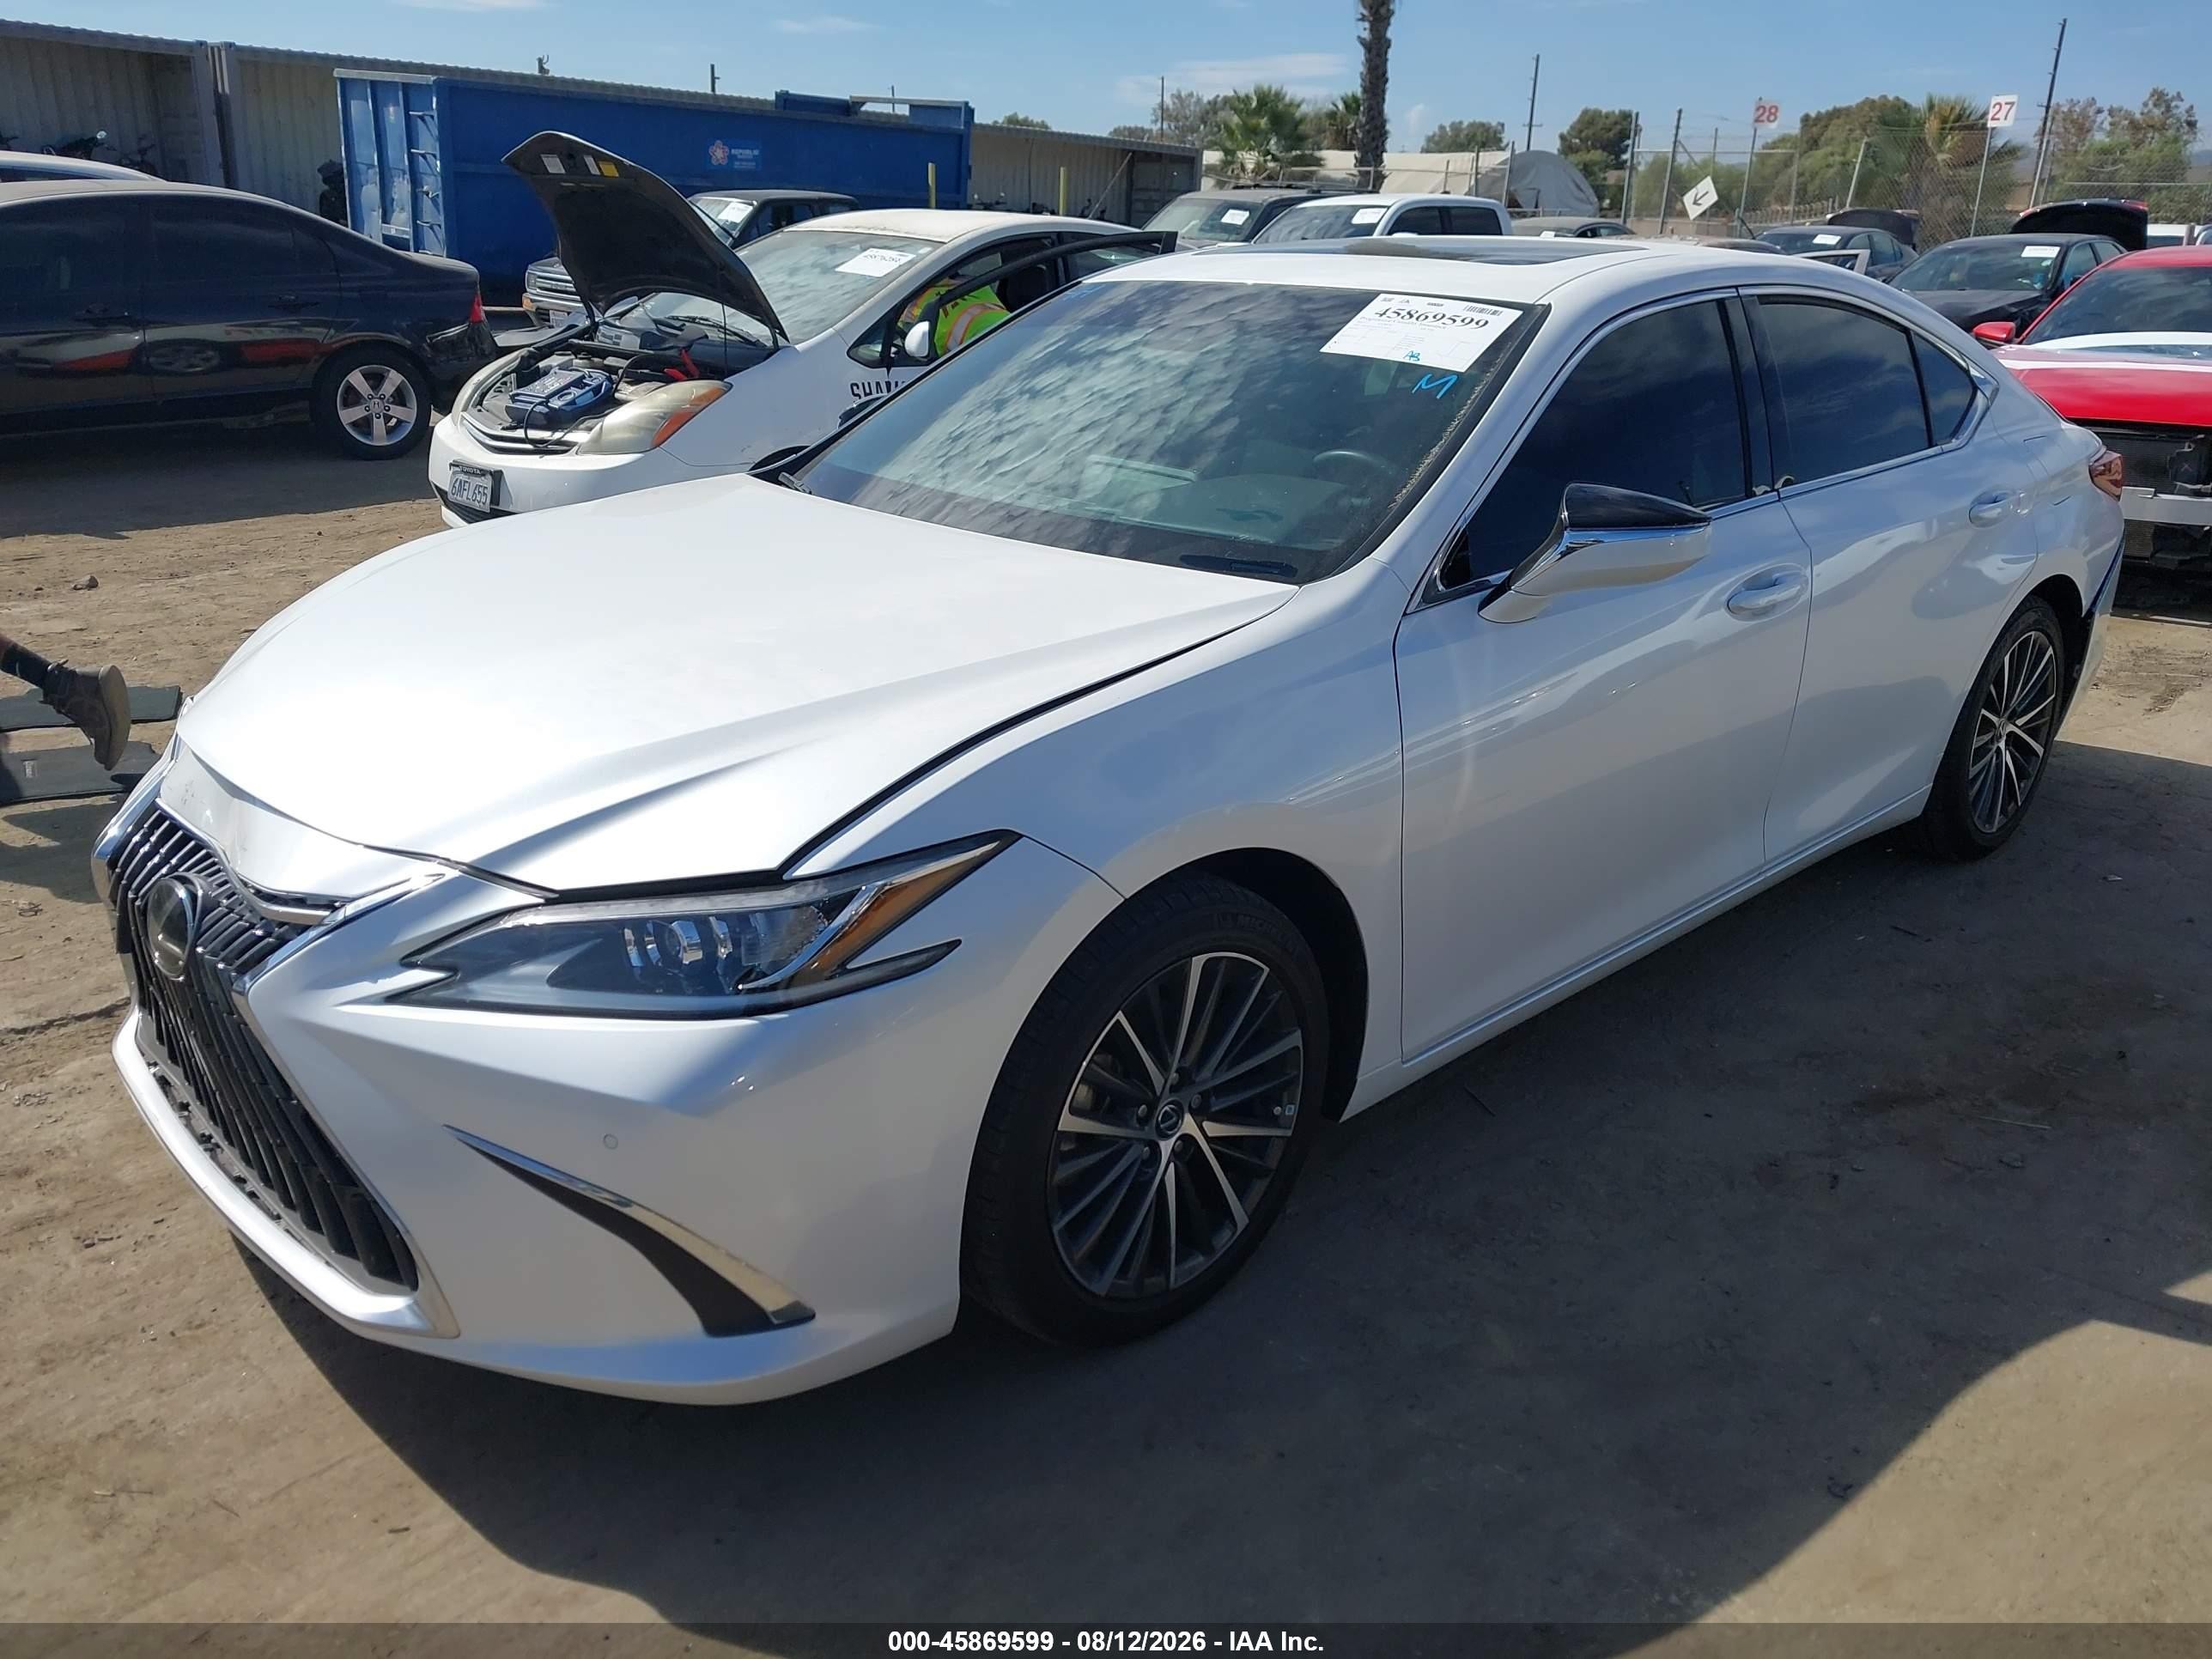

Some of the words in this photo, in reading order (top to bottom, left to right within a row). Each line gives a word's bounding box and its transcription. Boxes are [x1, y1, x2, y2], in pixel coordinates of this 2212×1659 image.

[1753, 105, 1778, 123] 28
[1990, 101, 2015, 121] 27
[1374, 307, 1490, 330] 45869599
[1411, 373, 1460, 399] M
[459, 465, 482, 475] TOYOTA
[451, 478, 489, 505] 6AFL655
